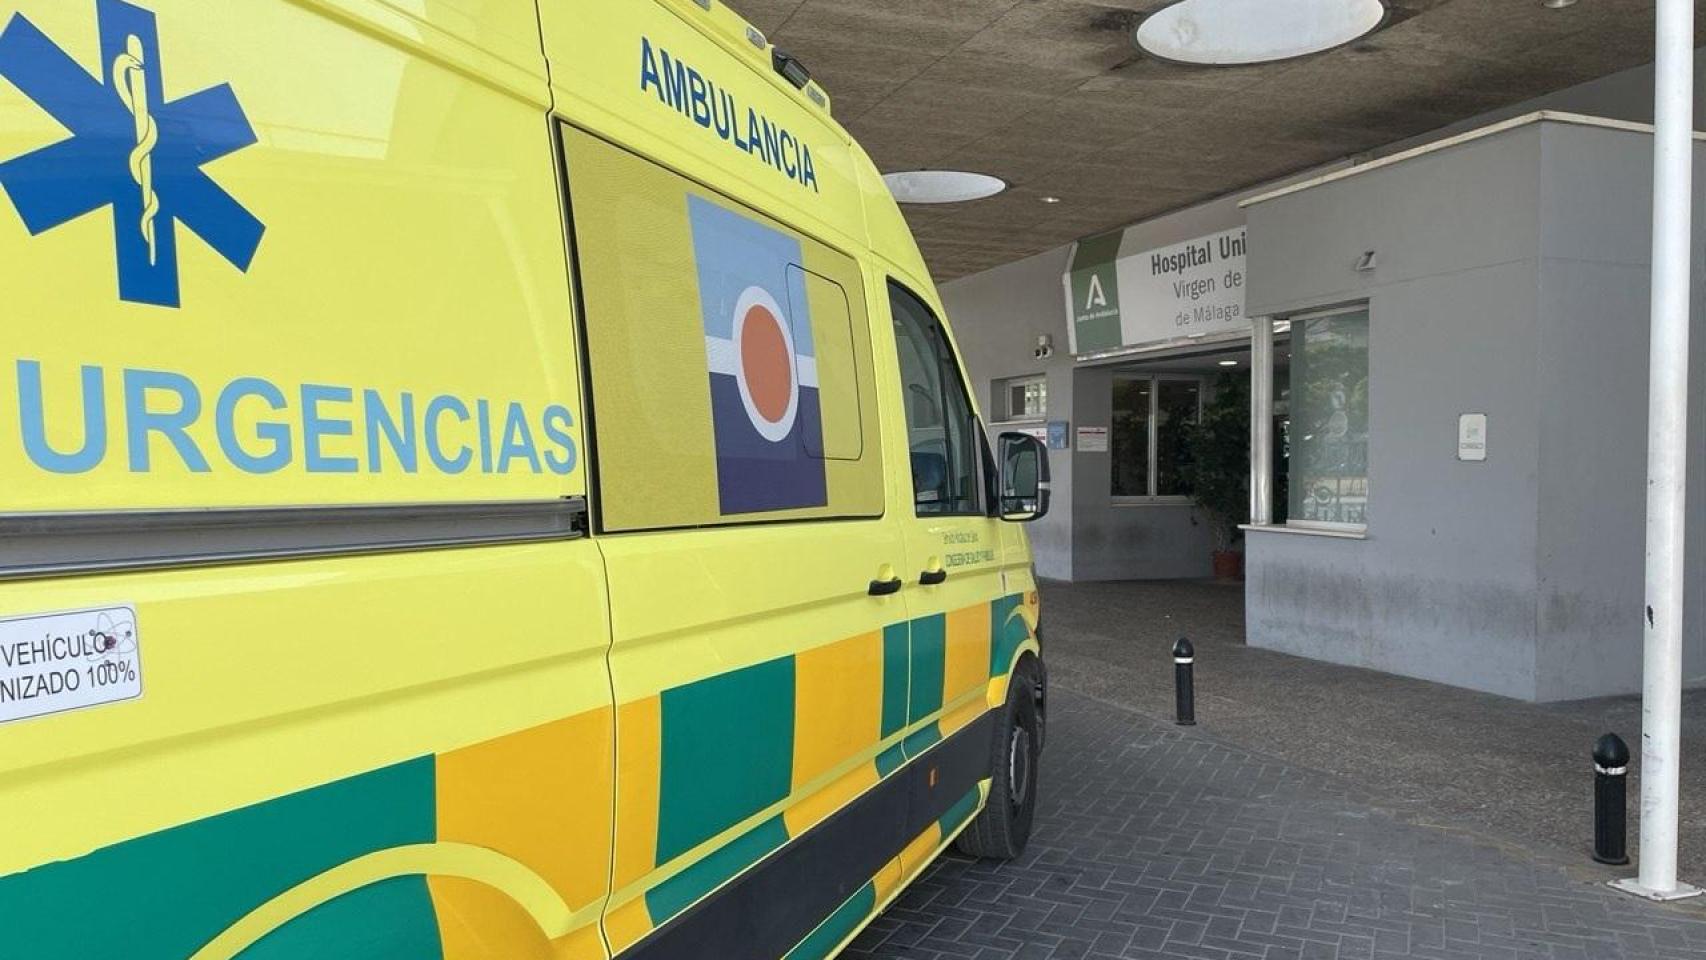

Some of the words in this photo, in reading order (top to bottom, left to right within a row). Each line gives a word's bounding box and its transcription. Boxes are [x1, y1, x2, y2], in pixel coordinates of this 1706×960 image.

[640, 35, 819, 194] AMBULANCIA
[1151, 241, 1212, 275] Hospital
[1219, 232, 1246, 260] Uni
[1173, 277, 1215, 300] Virgen
[1224, 270, 1242, 288] de
[1175, 311, 1190, 326] de
[1193, 302, 1240, 323] Málaga
[15, 358, 578, 475] URGENCIAS
[1, 631, 108, 667] VEHÍCULO
[0, 668, 80, 703] NIZADO
[87, 660, 136, 688] 100%
